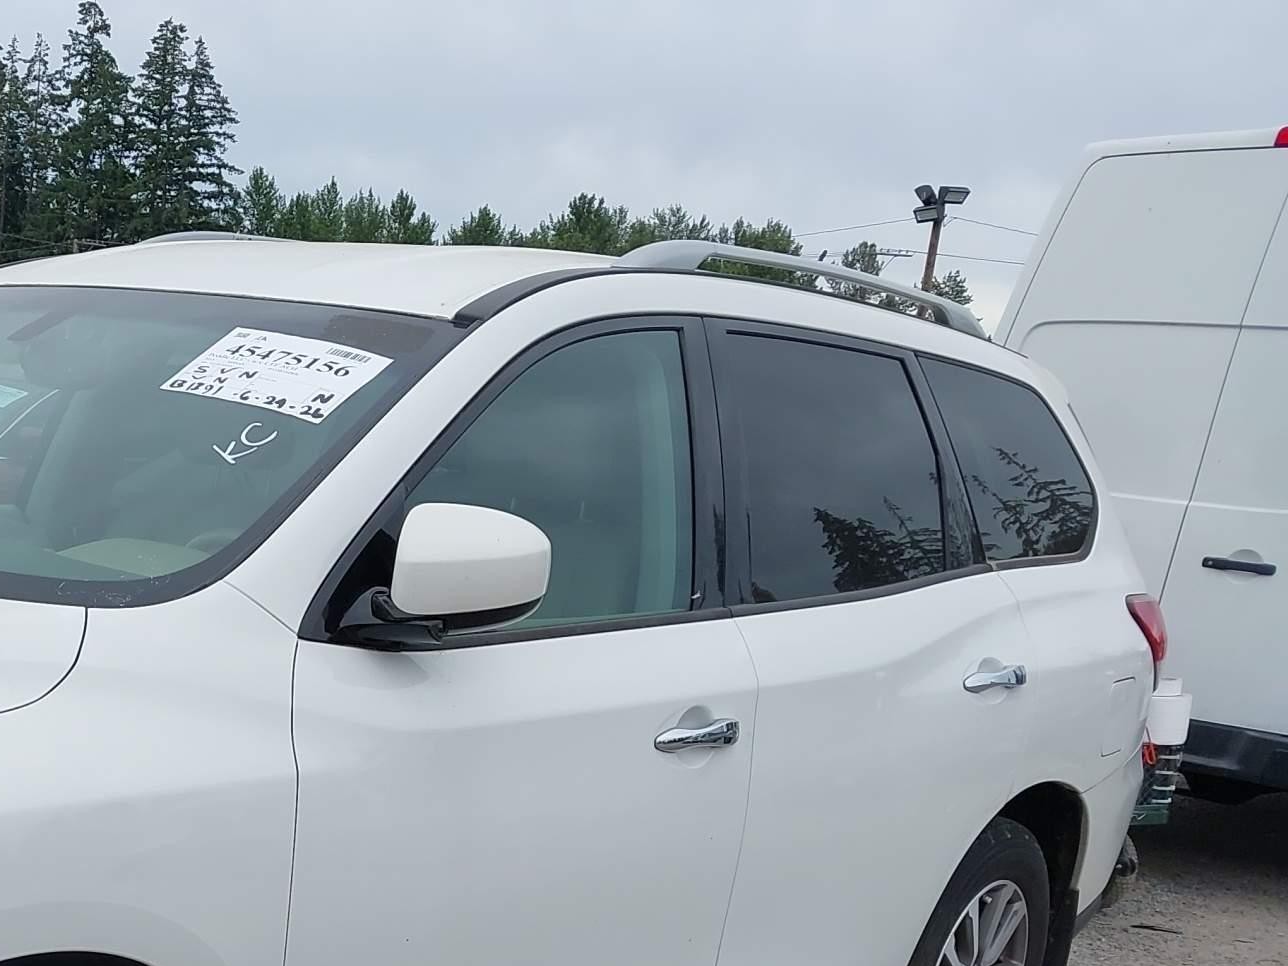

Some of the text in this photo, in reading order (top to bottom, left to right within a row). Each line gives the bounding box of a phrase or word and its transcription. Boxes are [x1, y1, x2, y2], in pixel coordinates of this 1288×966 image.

[226, 344, 355, 377] 45475156
[312, 393, 335, 404] N
[212, 422, 279, 465] KC
